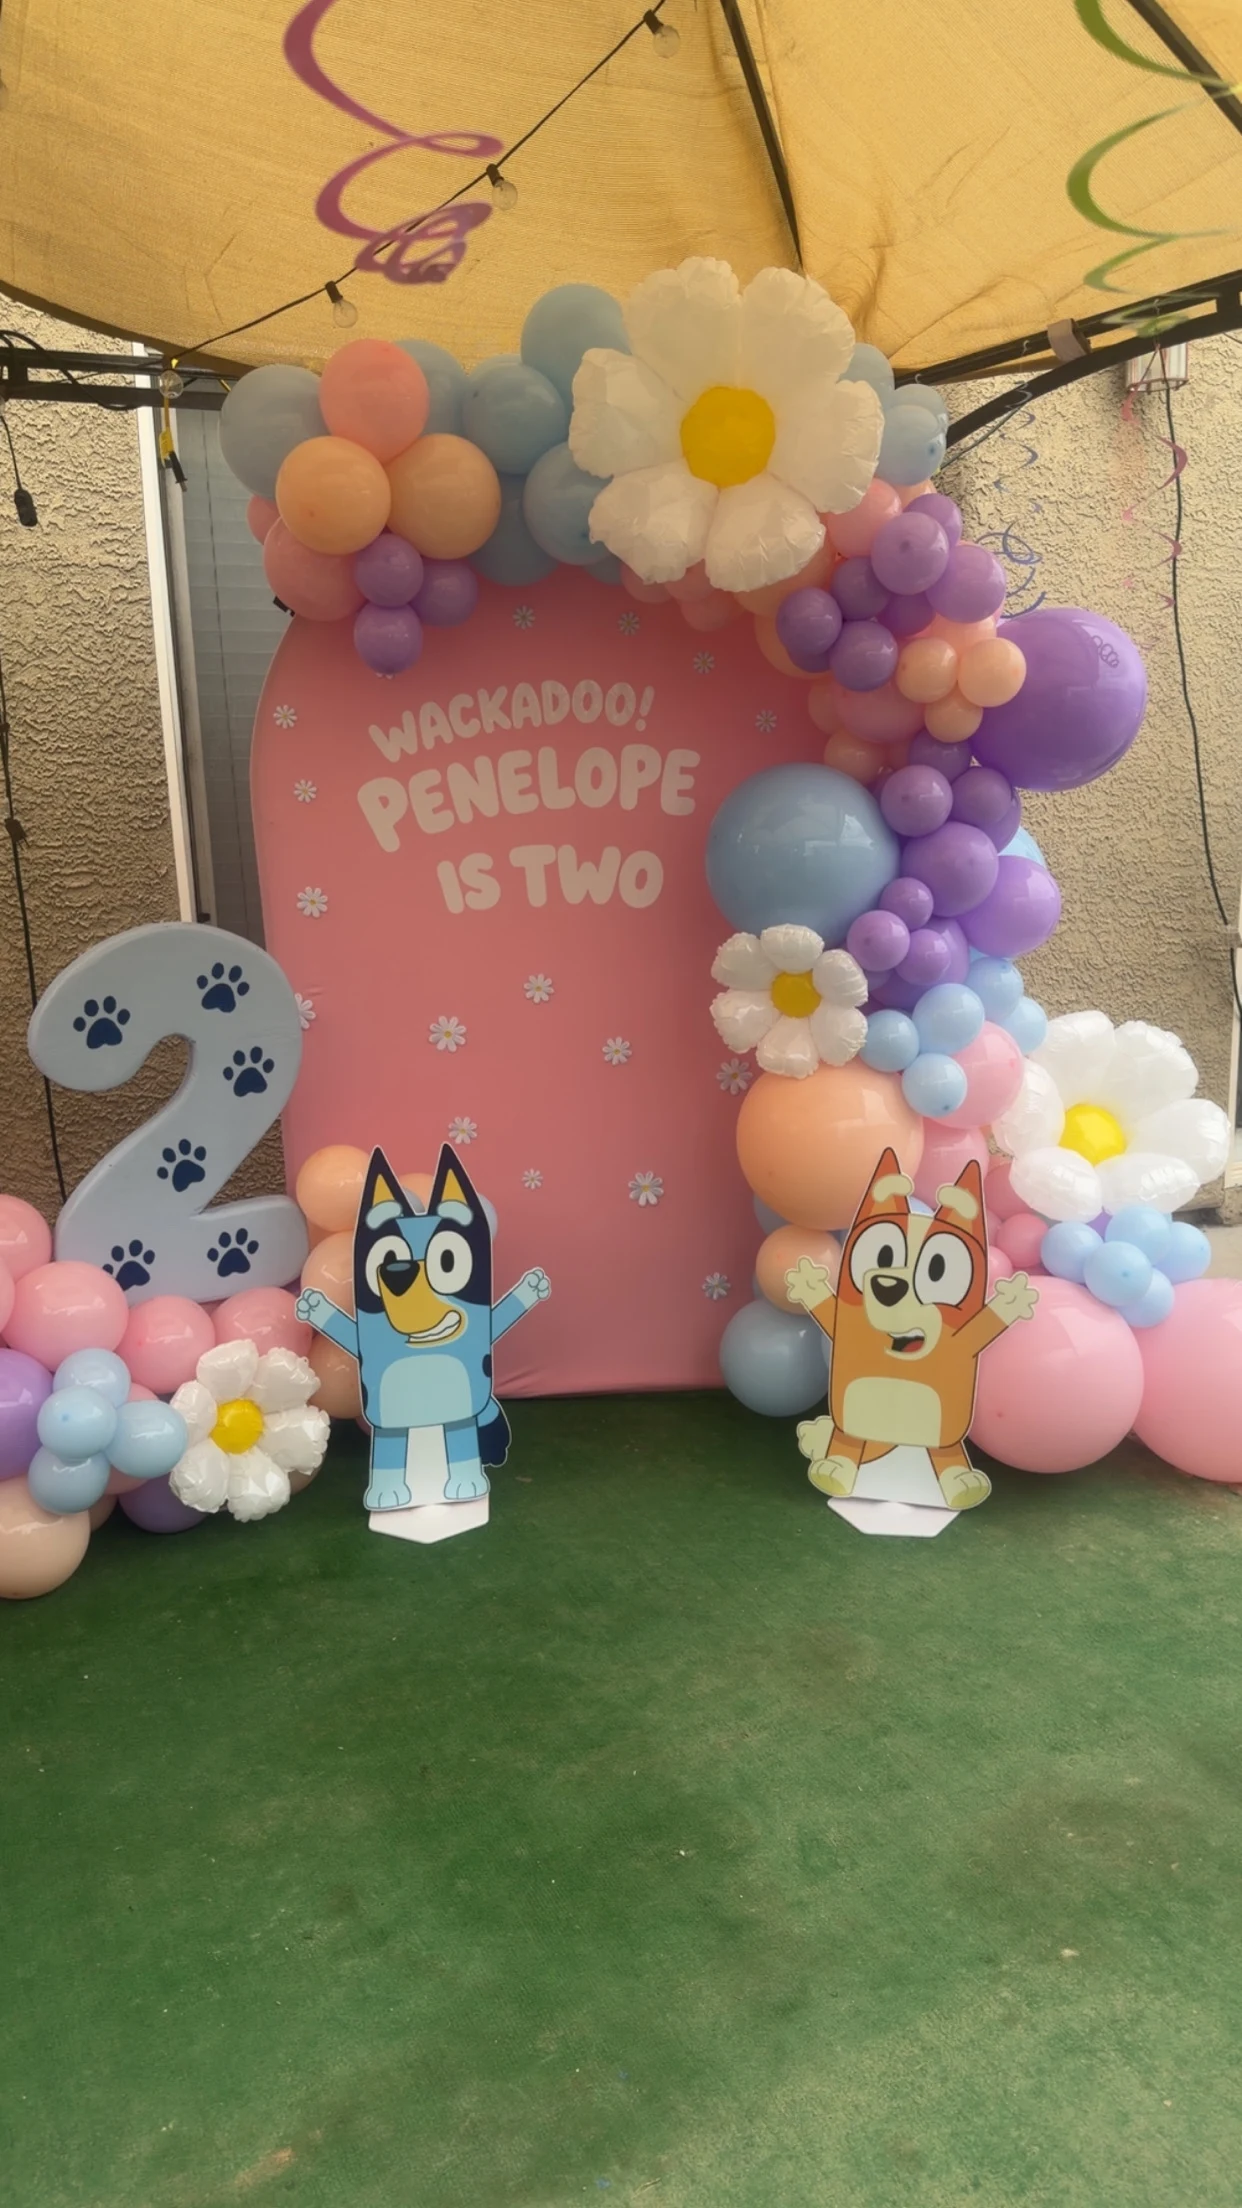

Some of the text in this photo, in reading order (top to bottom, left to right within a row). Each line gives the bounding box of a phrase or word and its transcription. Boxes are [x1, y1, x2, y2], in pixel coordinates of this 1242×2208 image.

[367, 679, 655, 763] WACKADOO!
[357, 744, 701, 853] PENELOPE
[436, 844, 664, 914] IS TWO
[27, 922, 309, 1304] 2
